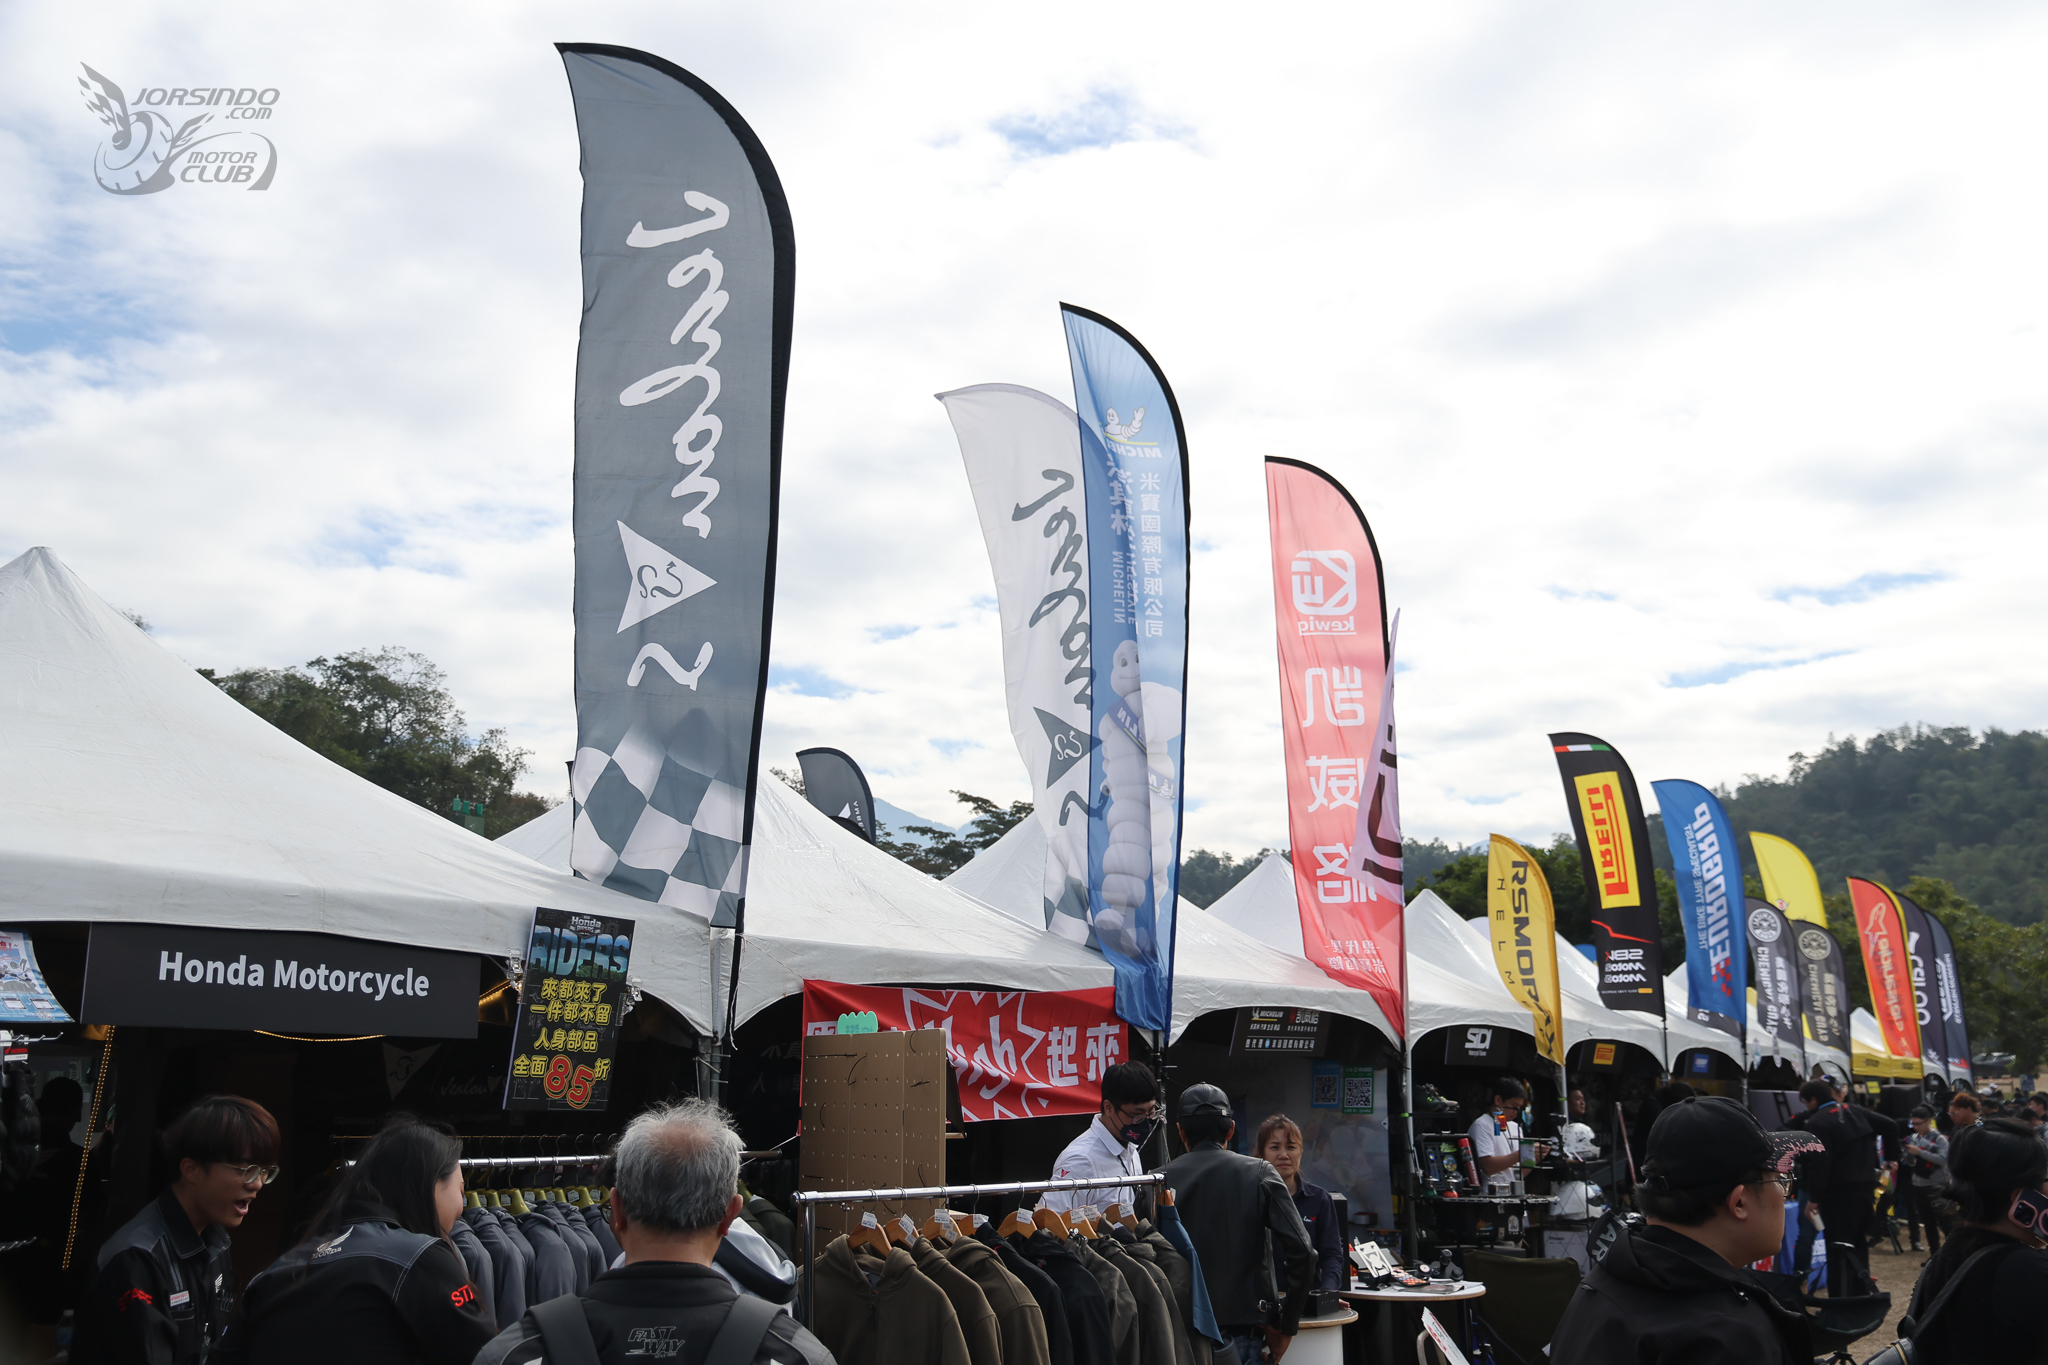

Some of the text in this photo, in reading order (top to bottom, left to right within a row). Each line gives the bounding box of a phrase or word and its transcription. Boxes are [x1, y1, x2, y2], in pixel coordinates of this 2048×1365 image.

[571, 915, 602, 929] Honda
[158, 950, 430, 1001] Honda Motorcycle
[541, 977, 607, 1004] 來都來了
[530, 1000, 612, 1026] 一件都不留
[534, 1027, 599, 1053] 人身部品
[1046, 1021, 1121, 1088] 起來
[628, 1326, 677, 1342] FAST
[643, 1338, 686, 1354] WAY
